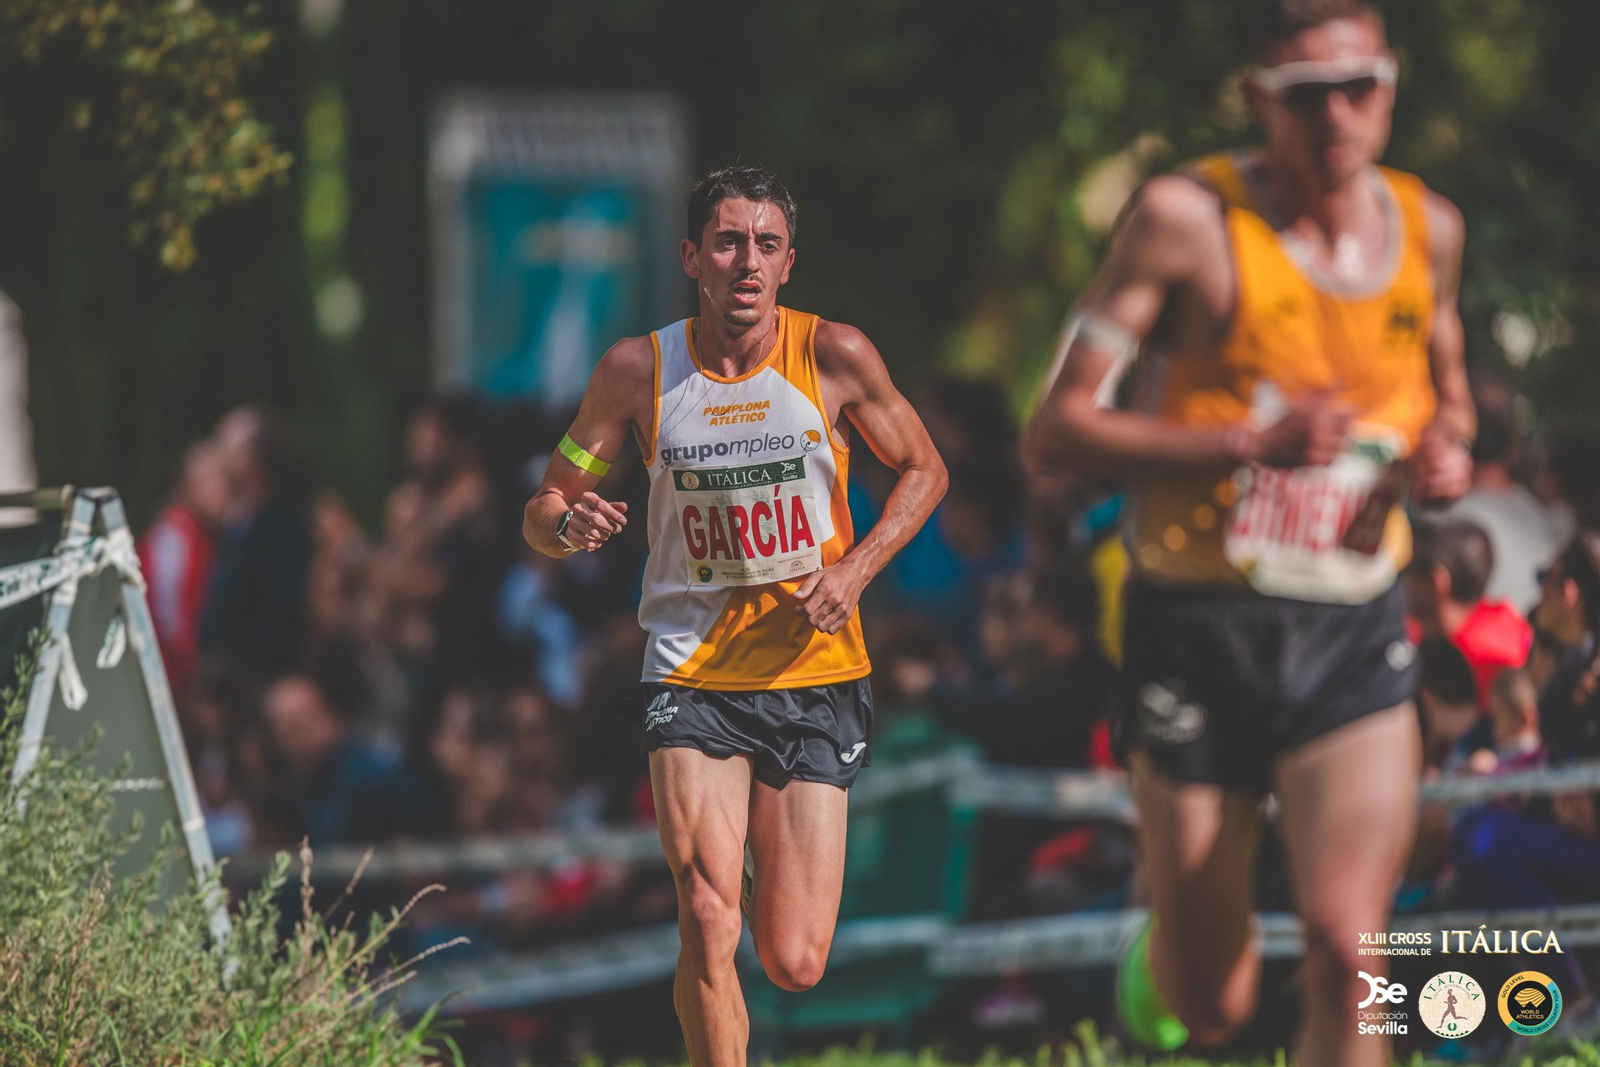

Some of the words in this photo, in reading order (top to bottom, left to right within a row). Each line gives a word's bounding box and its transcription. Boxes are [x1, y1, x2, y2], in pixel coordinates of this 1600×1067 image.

[703, 400, 771, 416] PAMPLONA
[709, 411, 766, 427] ATLÉTICO
[660, 433, 795, 466] grupompleo
[707, 468, 772, 486] ITÁLICA
[682, 484, 815, 561] GARCÍA
